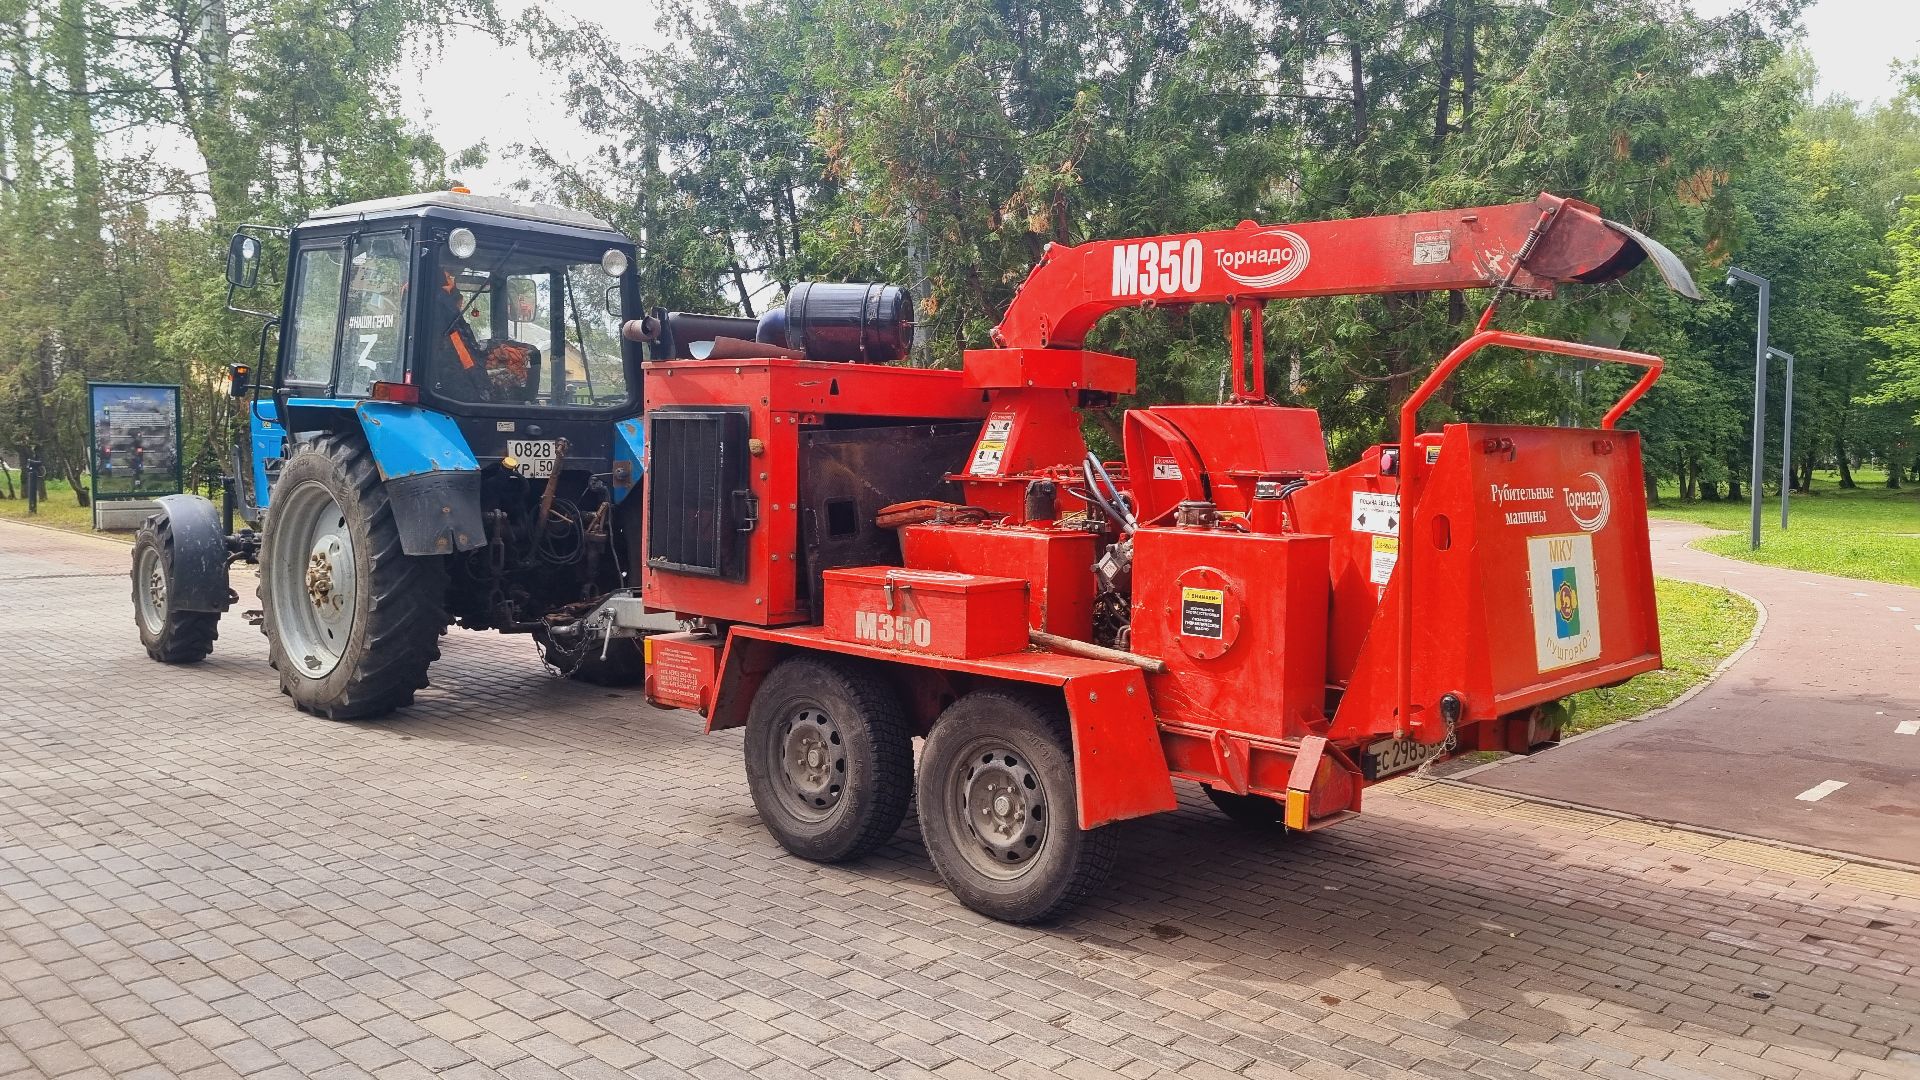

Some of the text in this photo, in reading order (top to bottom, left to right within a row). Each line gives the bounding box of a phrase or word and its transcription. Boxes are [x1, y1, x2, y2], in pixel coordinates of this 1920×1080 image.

[1112, 238, 1203, 296] М350
[1214, 247, 1293, 269] Торнадо
[358, 334, 378, 371] Z
[515, 442, 551, 458] 0828
[539, 460, 553, 472] 50
[1491, 483, 1555, 507] Рубительные
[1562, 487, 1603, 511] Торнадо
[1505, 510, 1547, 525] машины
[1548, 539, 1573, 562] МКУ
[855, 610, 931, 648] М350
[1546, 629, 1592, 661] ПУШГОРХОЗ
